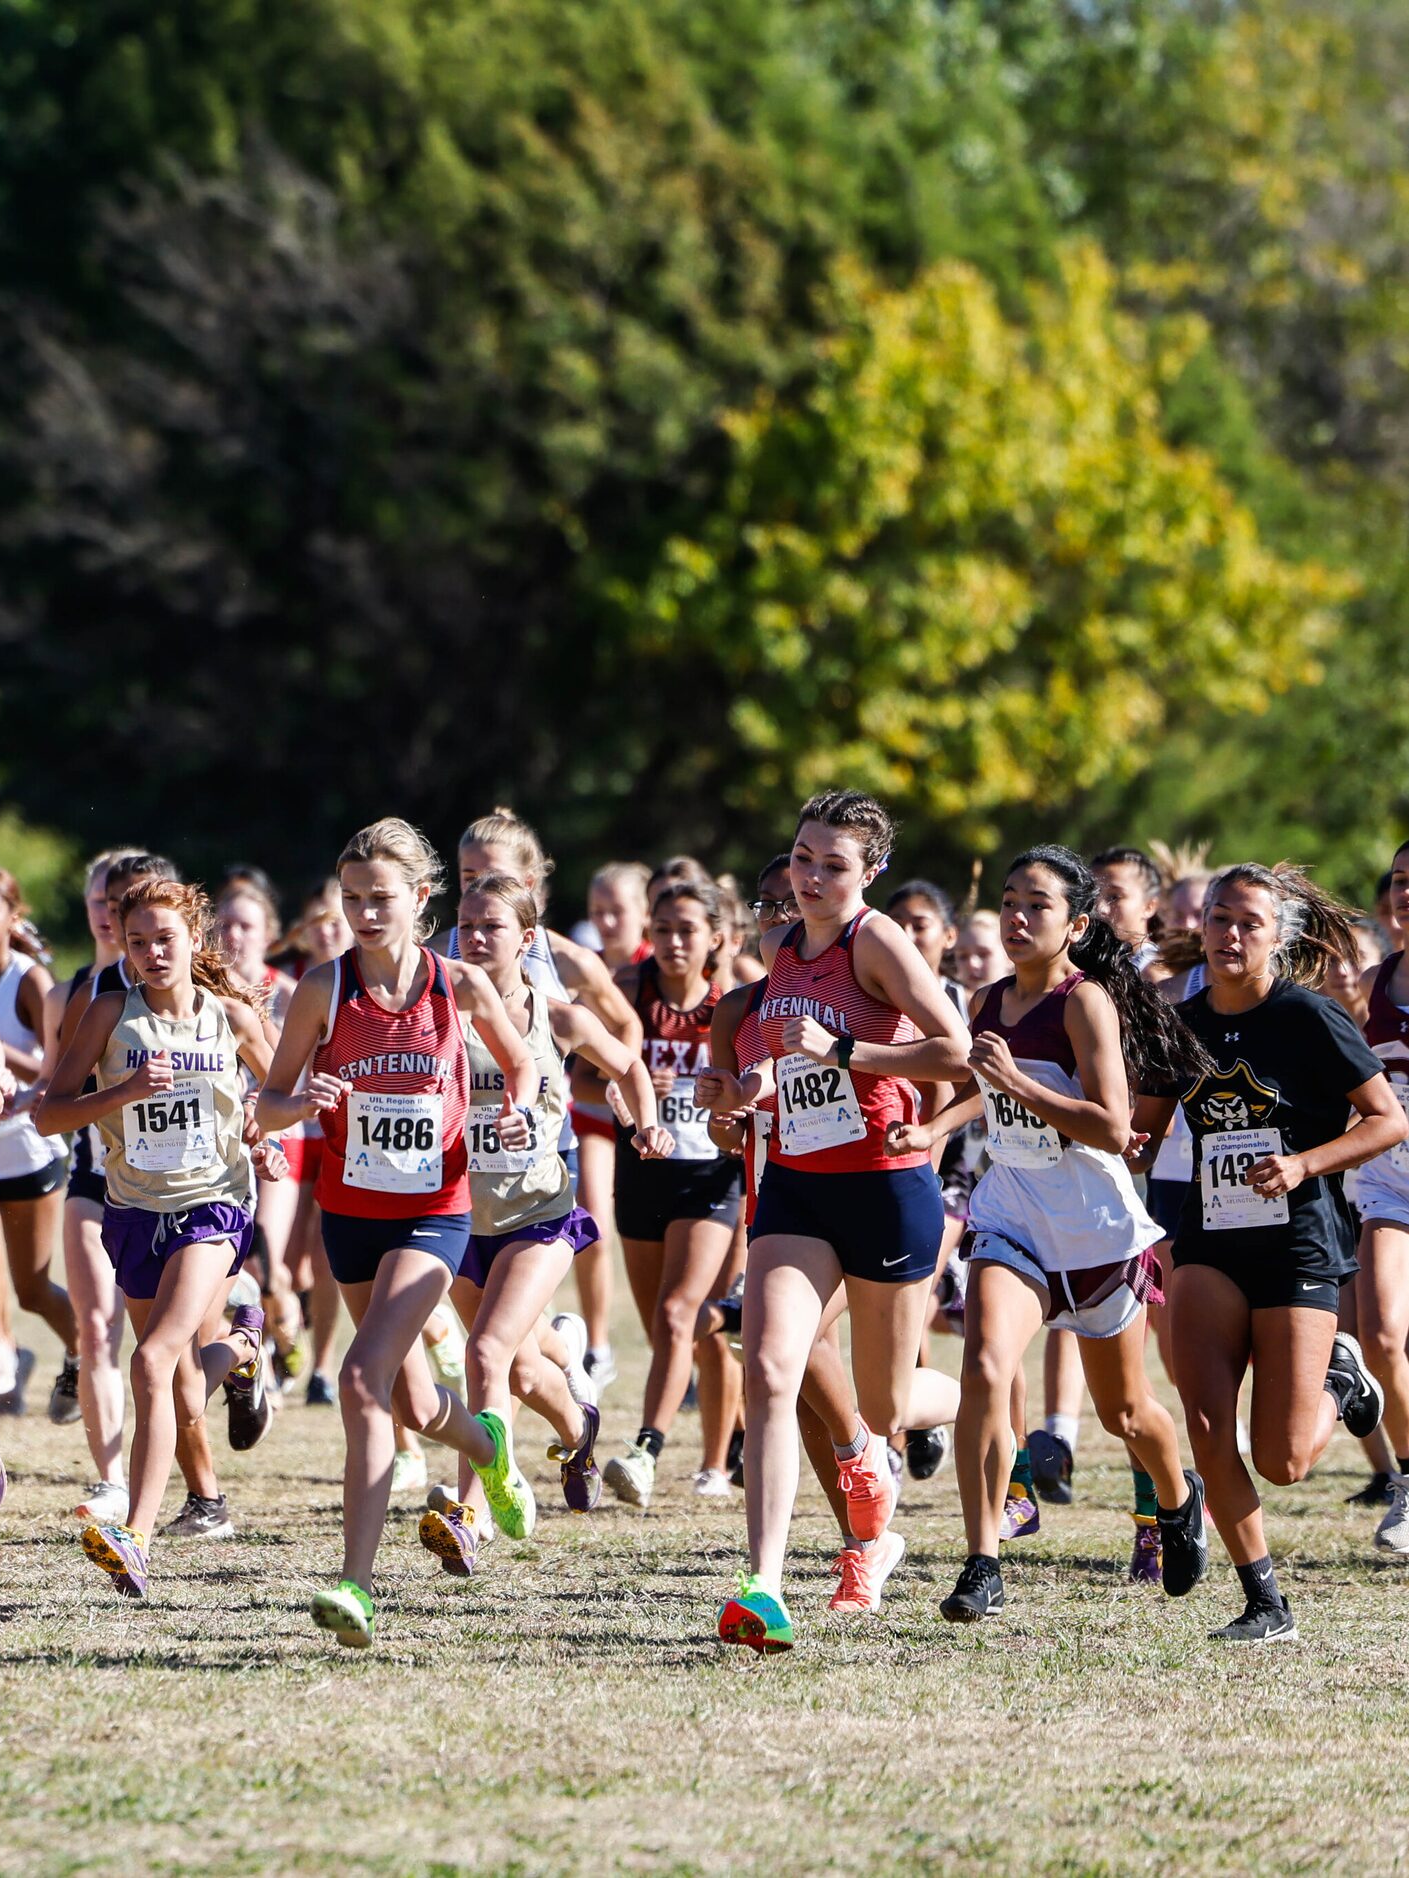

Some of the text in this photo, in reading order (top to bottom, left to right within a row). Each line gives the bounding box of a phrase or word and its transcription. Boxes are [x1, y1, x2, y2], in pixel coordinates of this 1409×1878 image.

[338, 1053, 453, 1081] CENTENNIAL
[386, 1097, 415, 1105] Region
[781, 1069, 847, 1114] 1482
[133, 1098, 200, 1133] 1541
[373, 1105, 431, 1114] Championship
[357, 1115, 434, 1151] 1486
[1221, 1141, 1271, 1151] Championship
